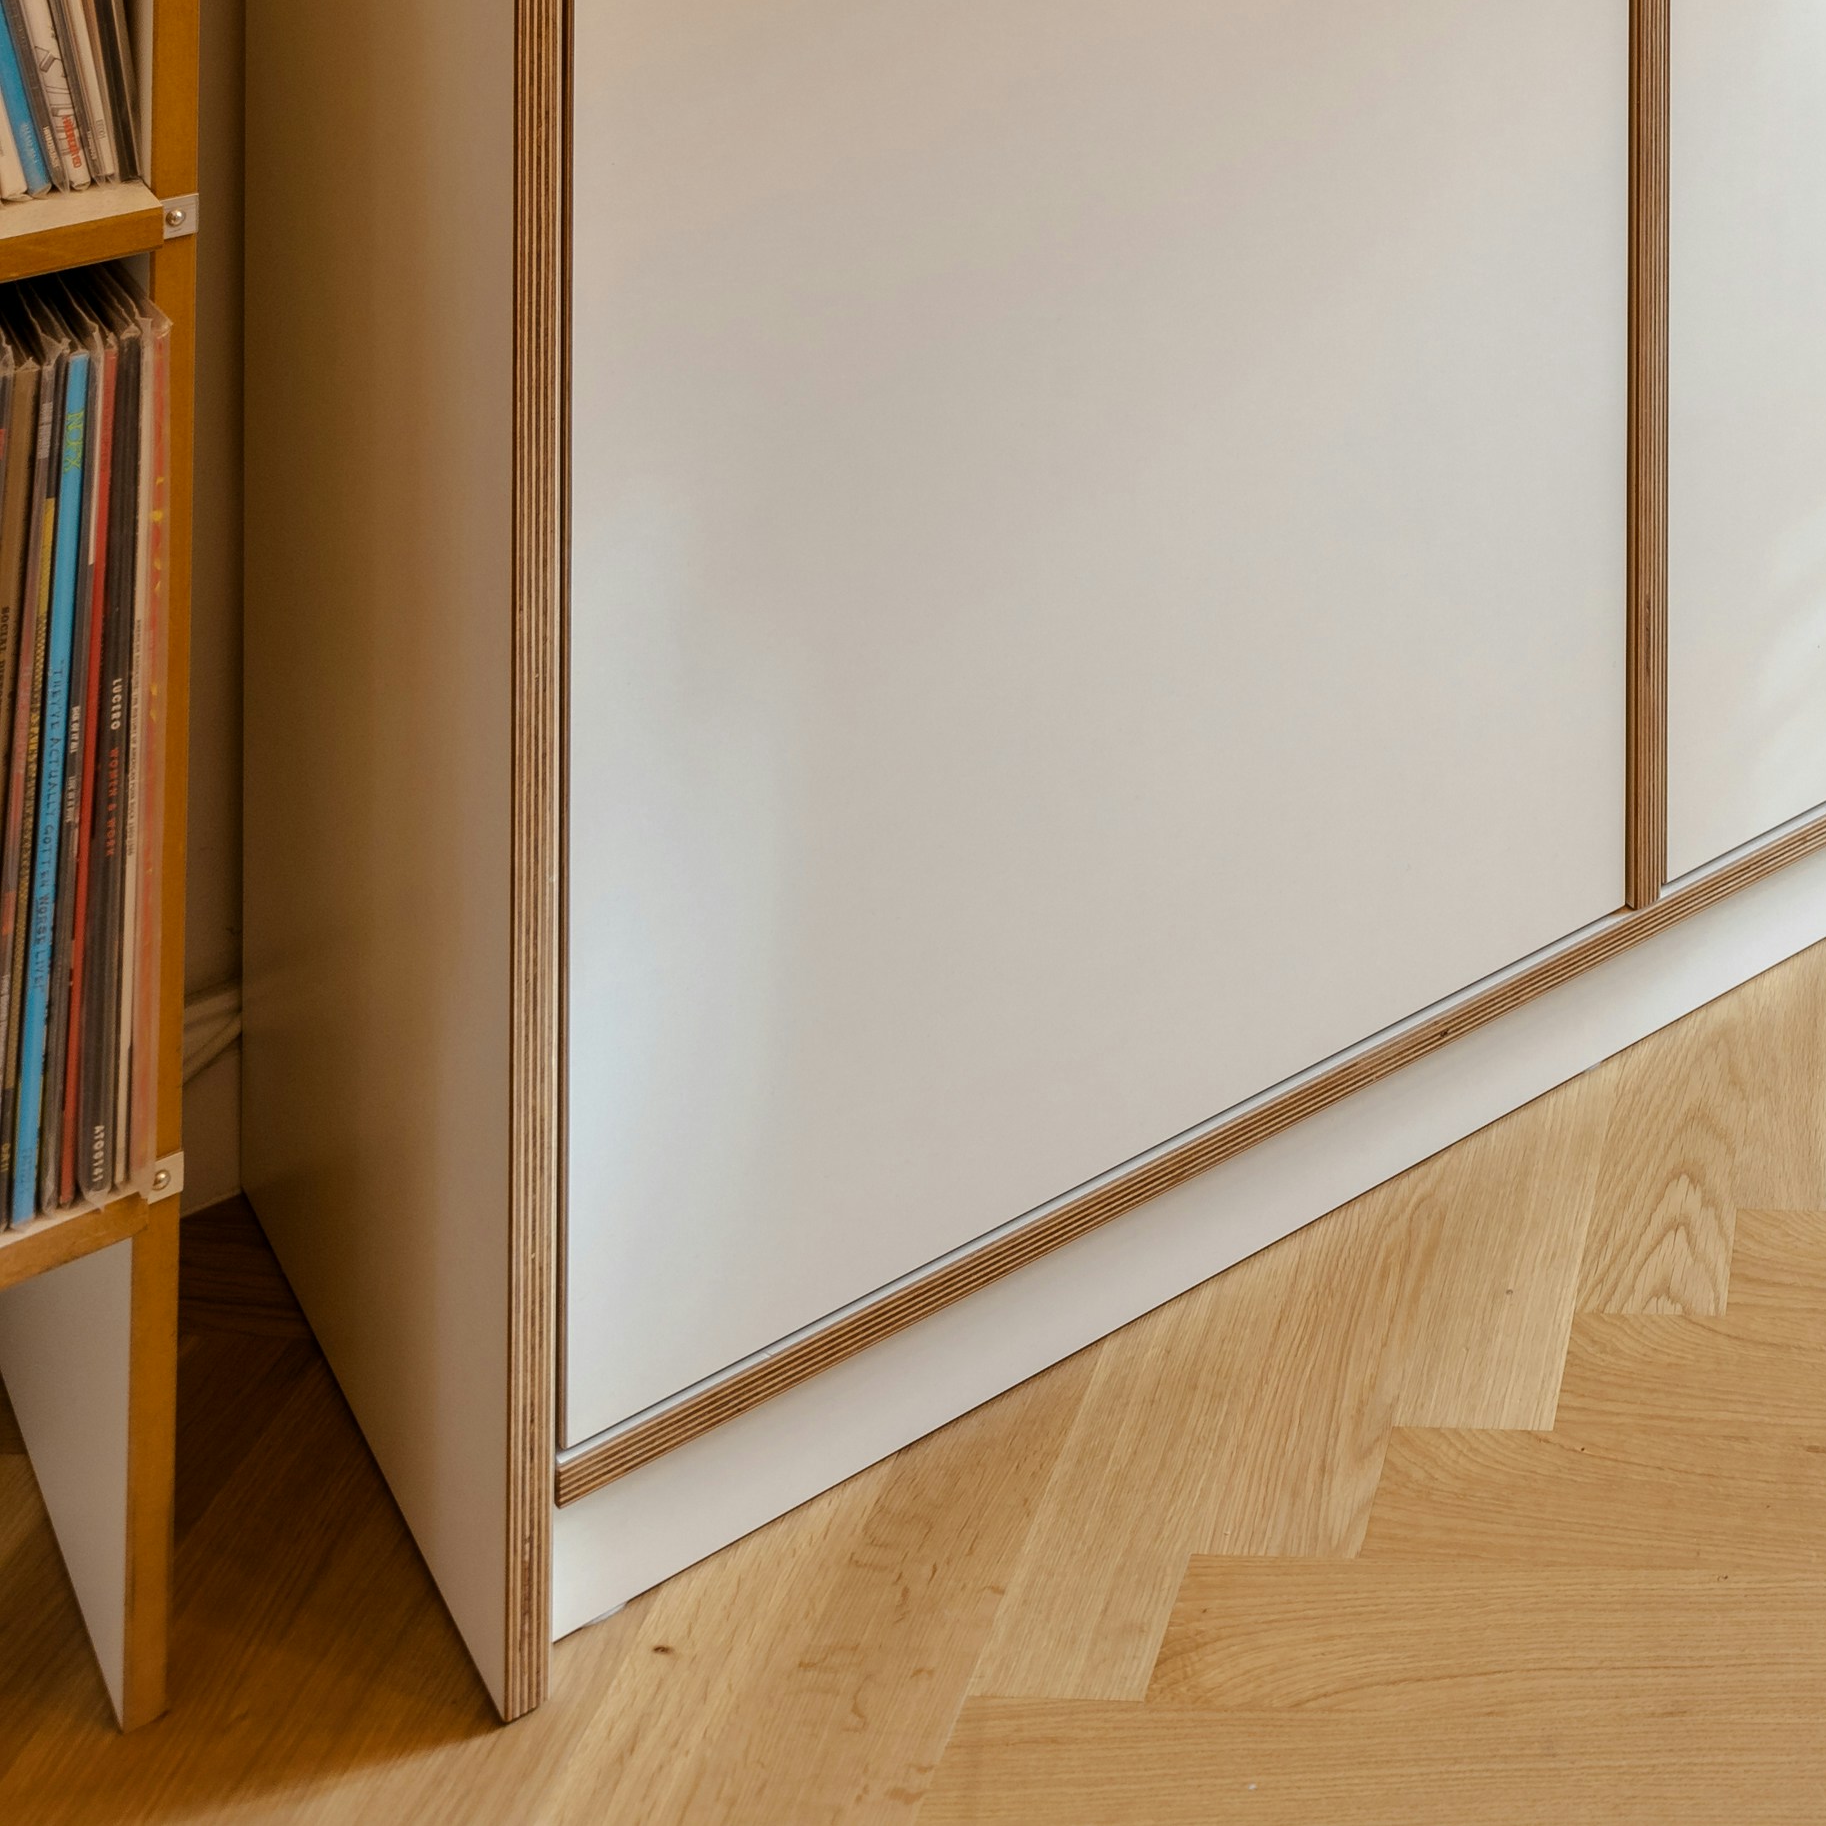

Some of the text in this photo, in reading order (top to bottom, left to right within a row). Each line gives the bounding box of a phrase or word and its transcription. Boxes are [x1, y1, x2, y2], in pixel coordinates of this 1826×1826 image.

[64, 411, 84, 474] NOFX
[110, 677, 123, 731] LUCERO
[35, 732, 62, 940] ACTUALLY GOTTEN WORSE
[105, 815, 117, 856] WORK
